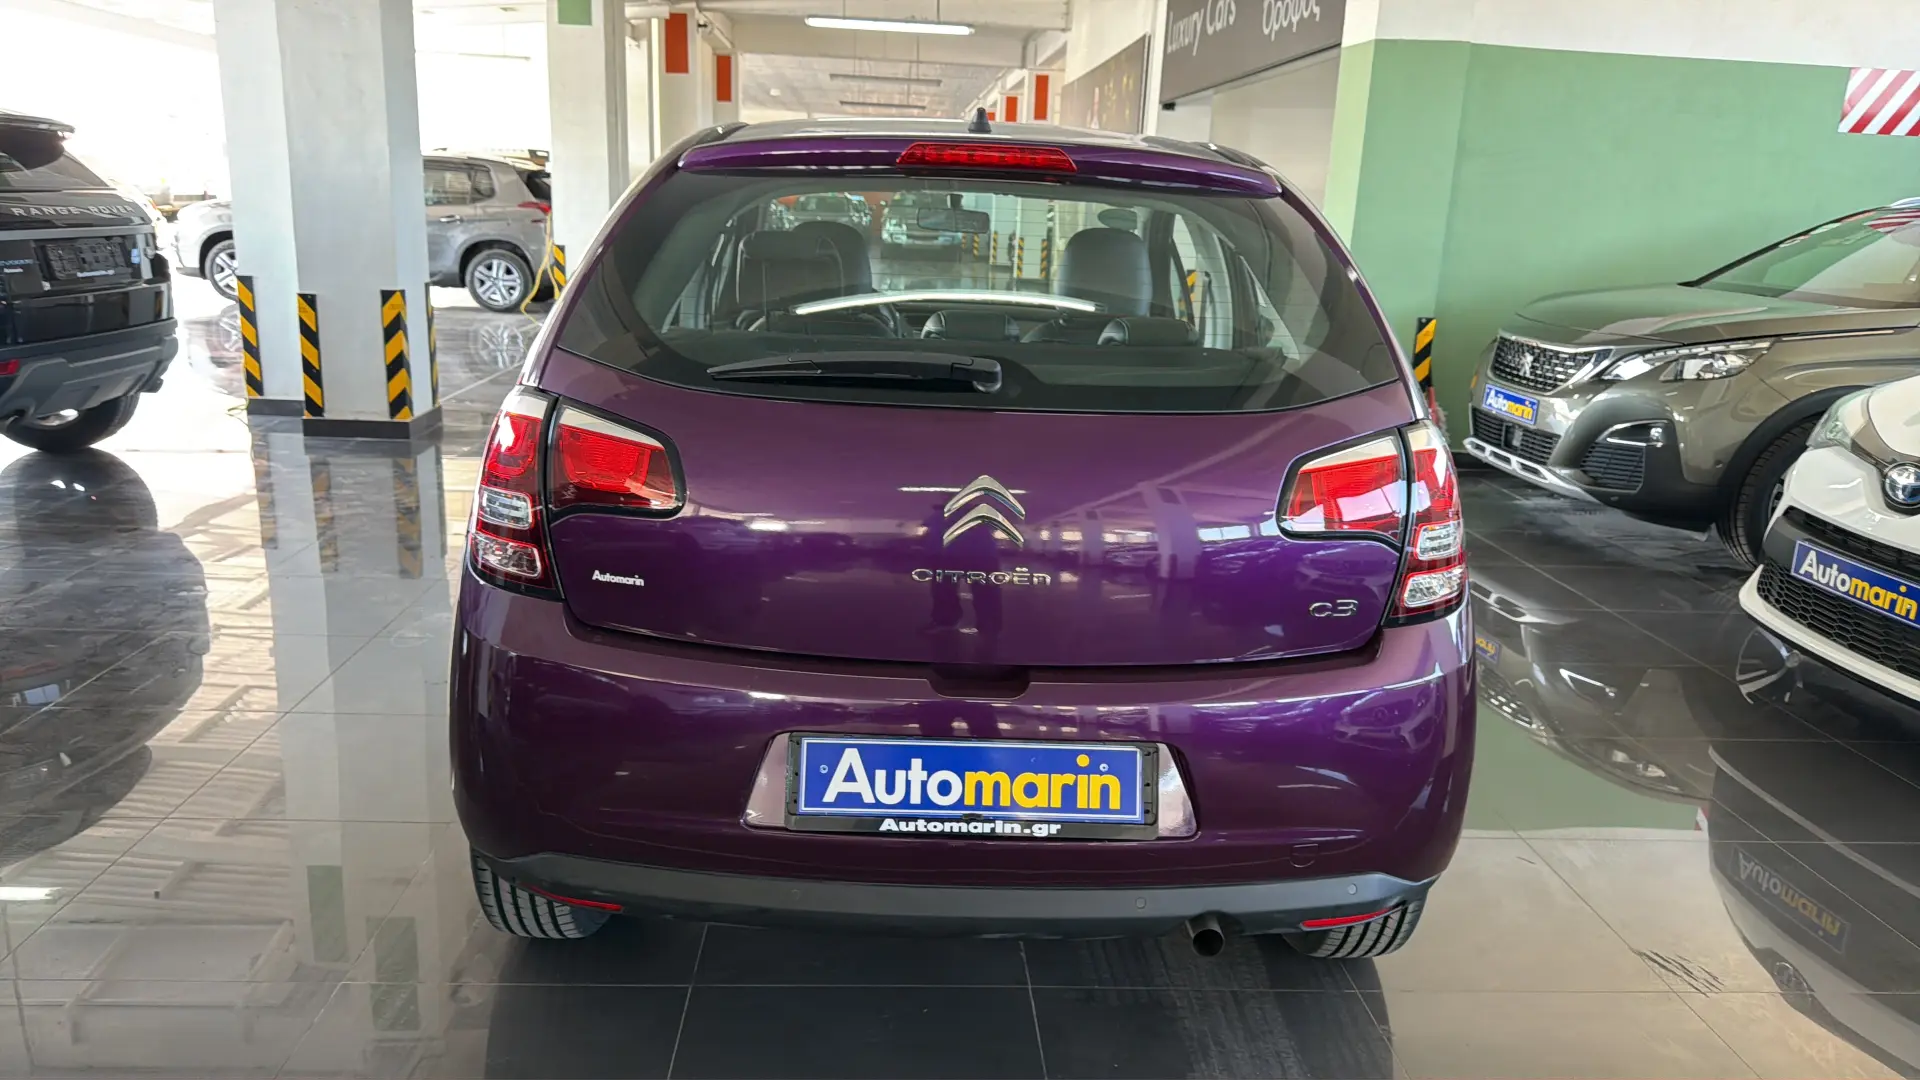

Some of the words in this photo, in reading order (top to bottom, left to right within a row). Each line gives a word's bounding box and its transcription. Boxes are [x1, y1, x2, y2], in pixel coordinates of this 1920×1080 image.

[1167, 8, 1204, 56] Luxury
[1206, 0, 1236, 36] Cars
[11, 206, 81, 216] RANGE
[87, 205, 135, 214] ROVER
[1486, 389, 1534, 420] Automarin
[592, 569, 645, 587] Automarin
[1799, 549, 1918, 620] Automarin
[1309, 599, 1359, 617] C3
[822, 748, 1121, 810] Automarin
[879, 818, 1062, 837] Automarin.gr
